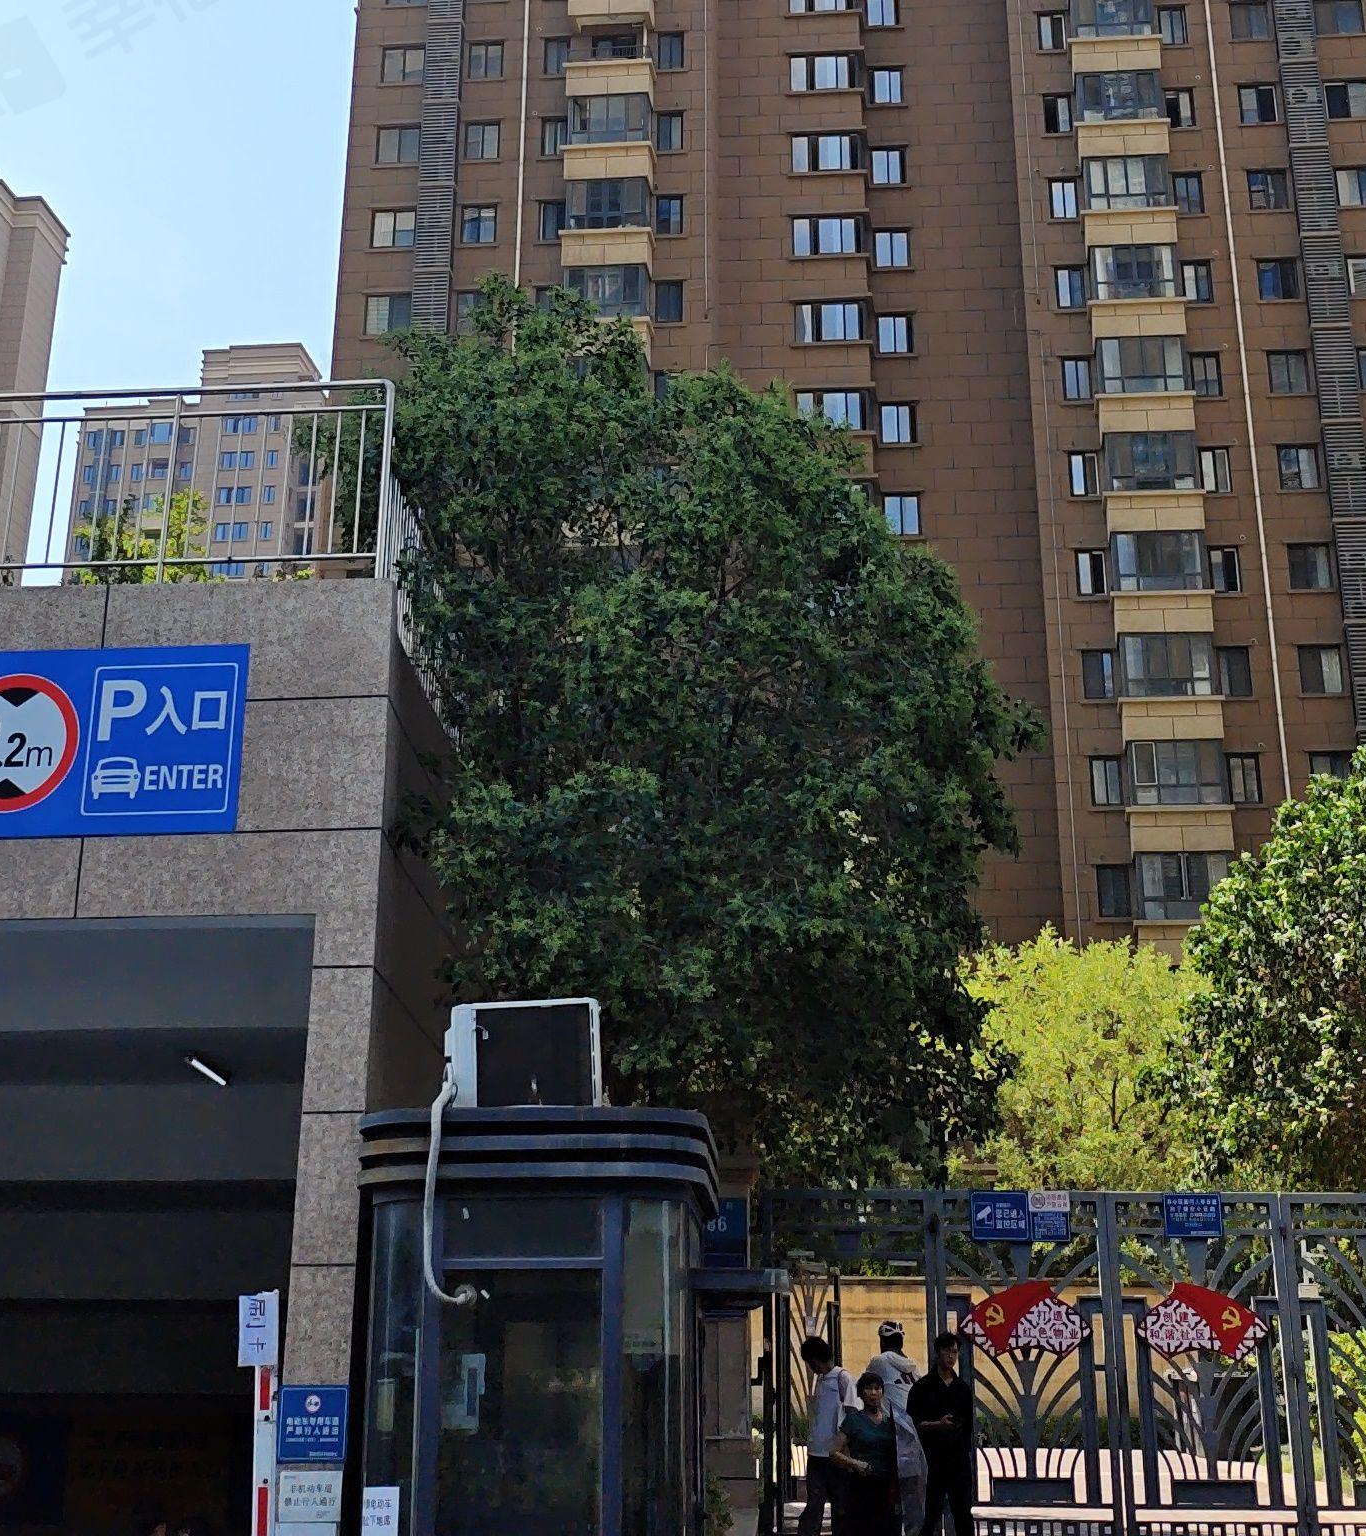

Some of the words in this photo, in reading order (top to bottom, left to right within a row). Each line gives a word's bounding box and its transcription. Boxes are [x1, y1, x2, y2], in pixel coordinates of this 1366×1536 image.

[143, 764, 223, 791] ENTER
[1023, 1327, 1079, 1340] 红色物业
[1150, 1328, 1205, 1341] 和谐社区
